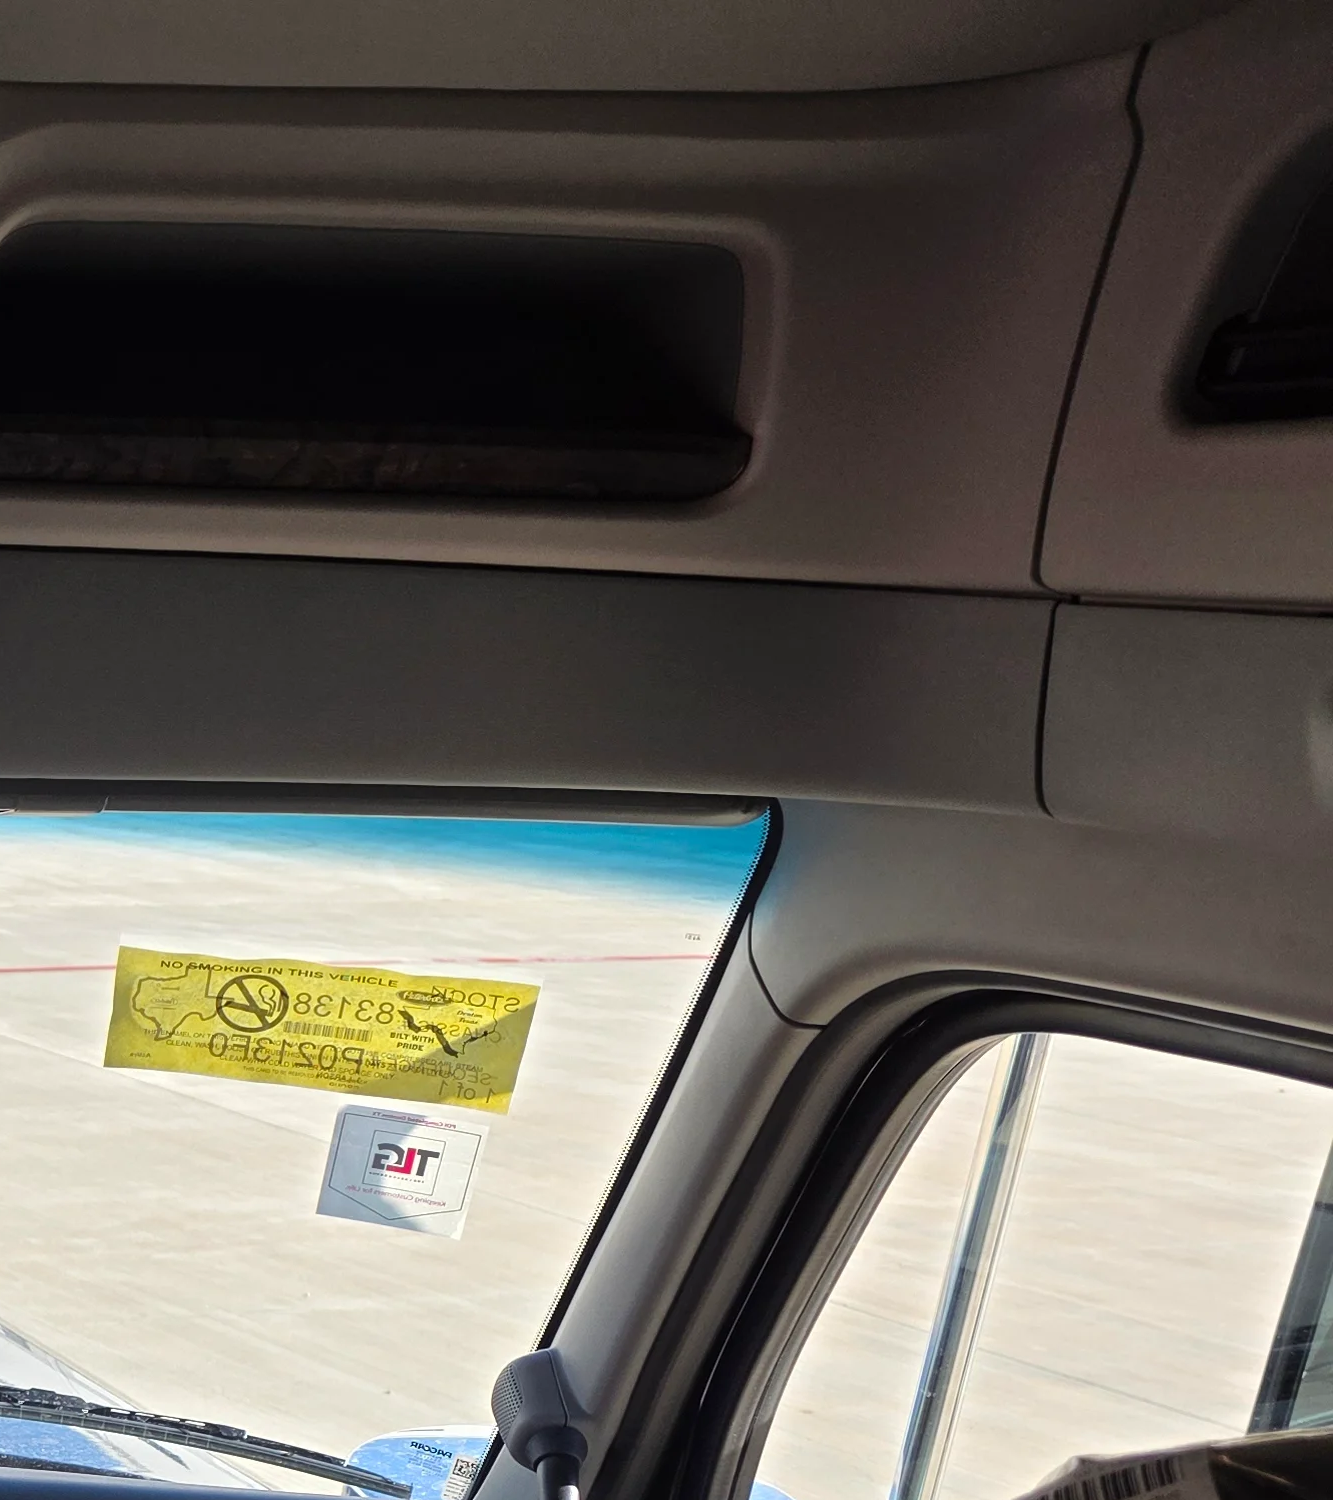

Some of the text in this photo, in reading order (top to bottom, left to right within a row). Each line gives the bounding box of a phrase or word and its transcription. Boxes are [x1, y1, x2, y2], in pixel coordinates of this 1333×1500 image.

[160, 960, 399, 989] NO SMOKING IN THIS VEHICLE
[390, 1032, 435, 1044] BILT WITH
[396, 1042, 424, 1052] PRIDE
